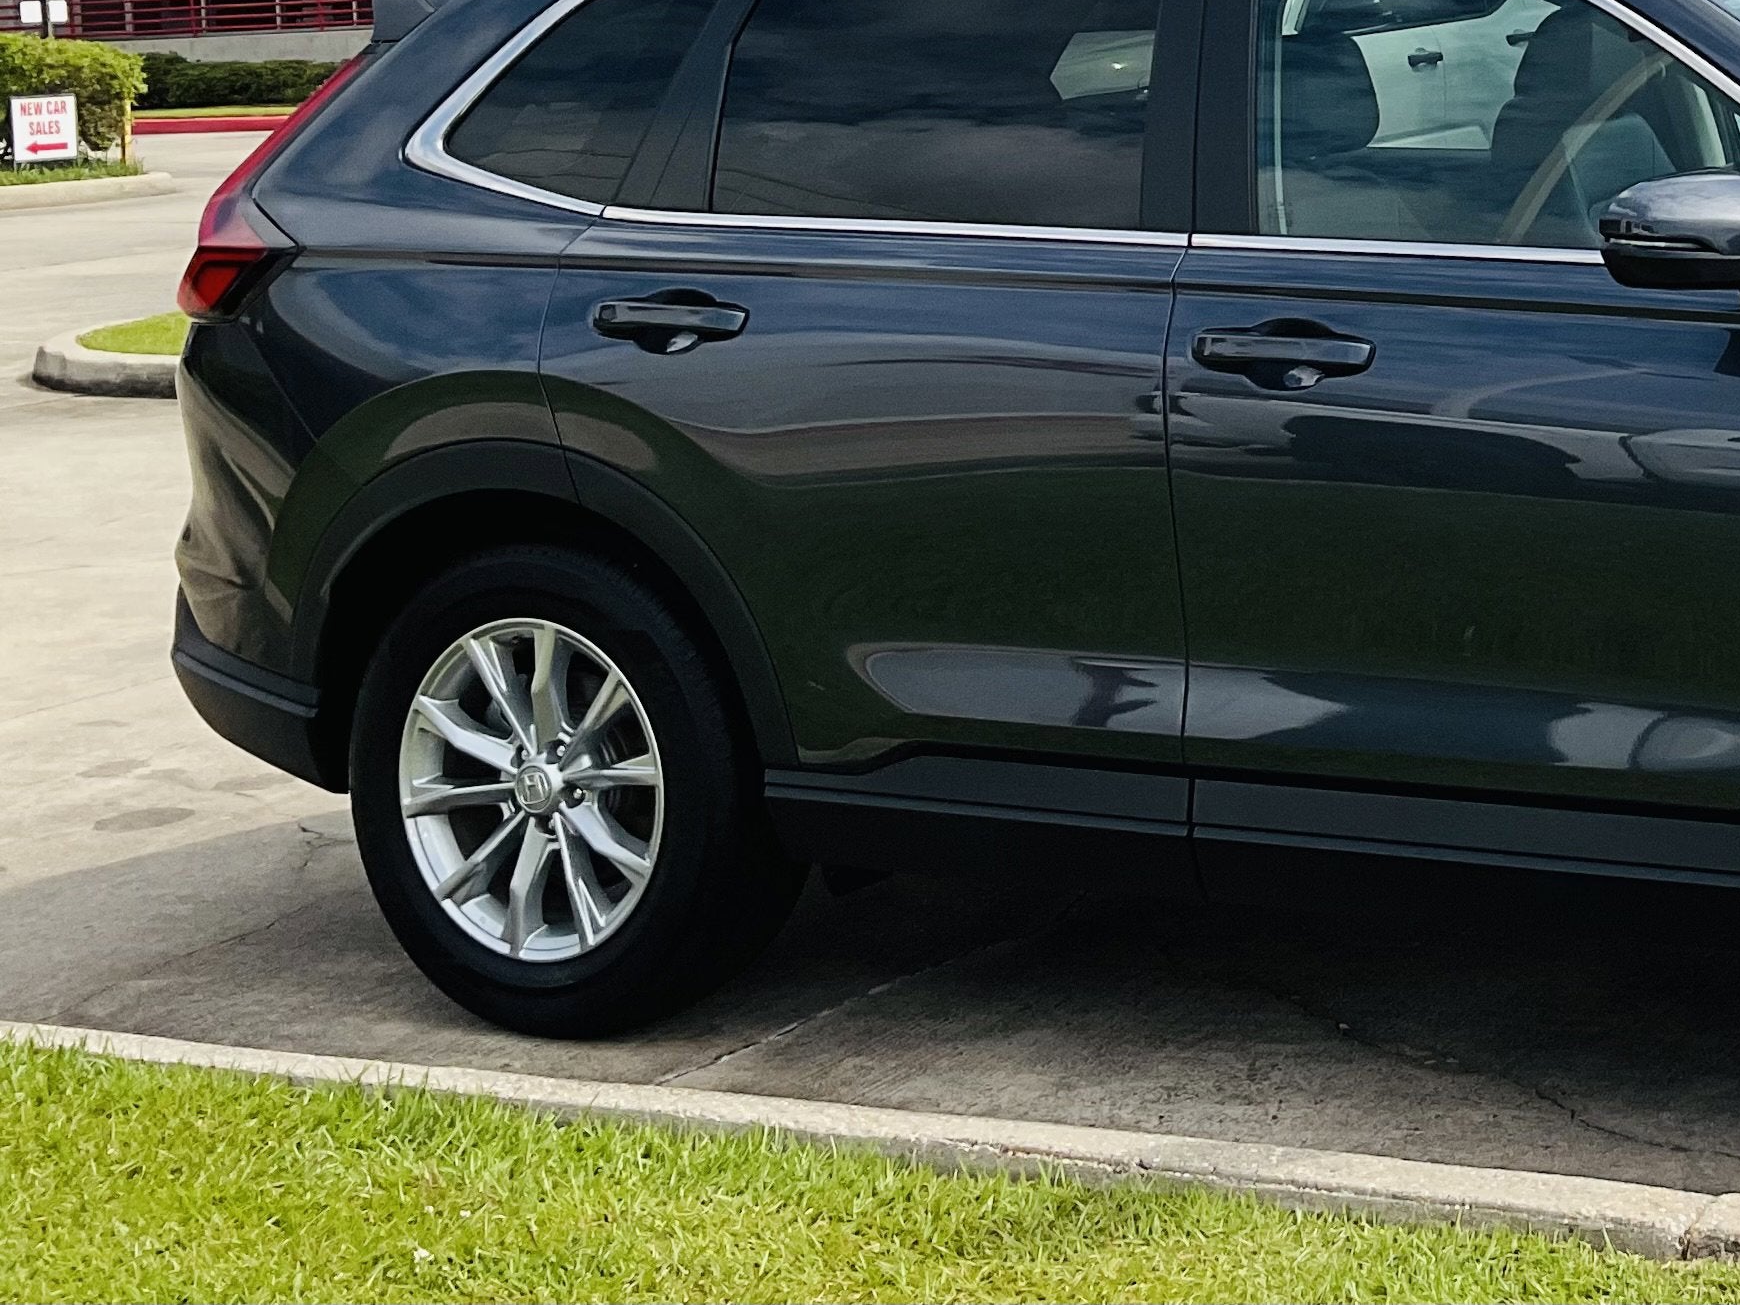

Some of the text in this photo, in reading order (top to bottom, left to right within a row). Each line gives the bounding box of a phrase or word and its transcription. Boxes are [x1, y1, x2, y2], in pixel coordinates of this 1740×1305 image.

[20, 100, 67, 116] NEW CAR
[29, 120, 61, 136] SALES
